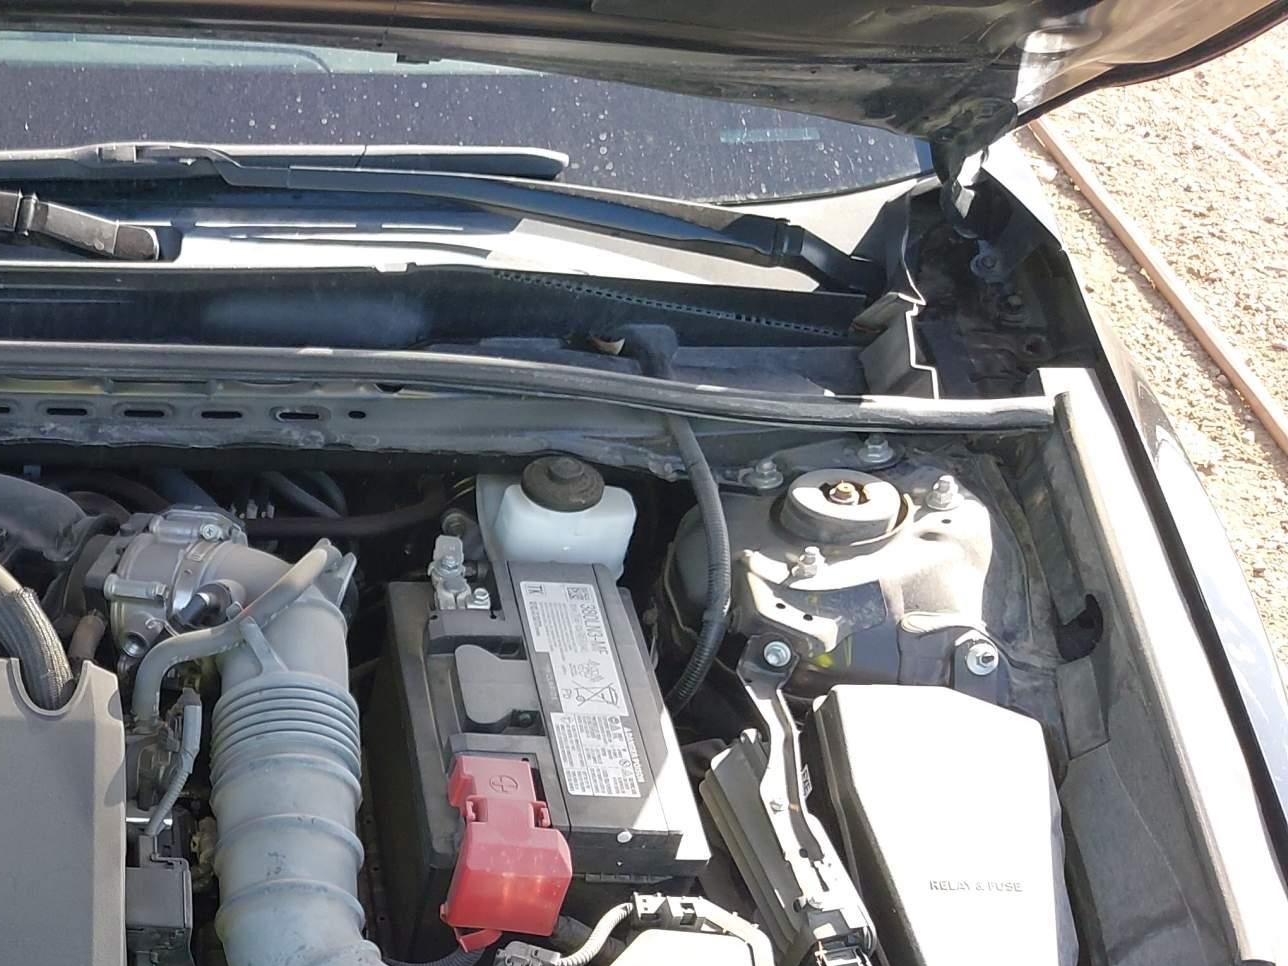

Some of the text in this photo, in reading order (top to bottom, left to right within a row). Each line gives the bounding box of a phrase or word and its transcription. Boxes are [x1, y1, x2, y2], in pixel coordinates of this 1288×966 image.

[929, 880, 1023, 893] RELAY & FUSE
